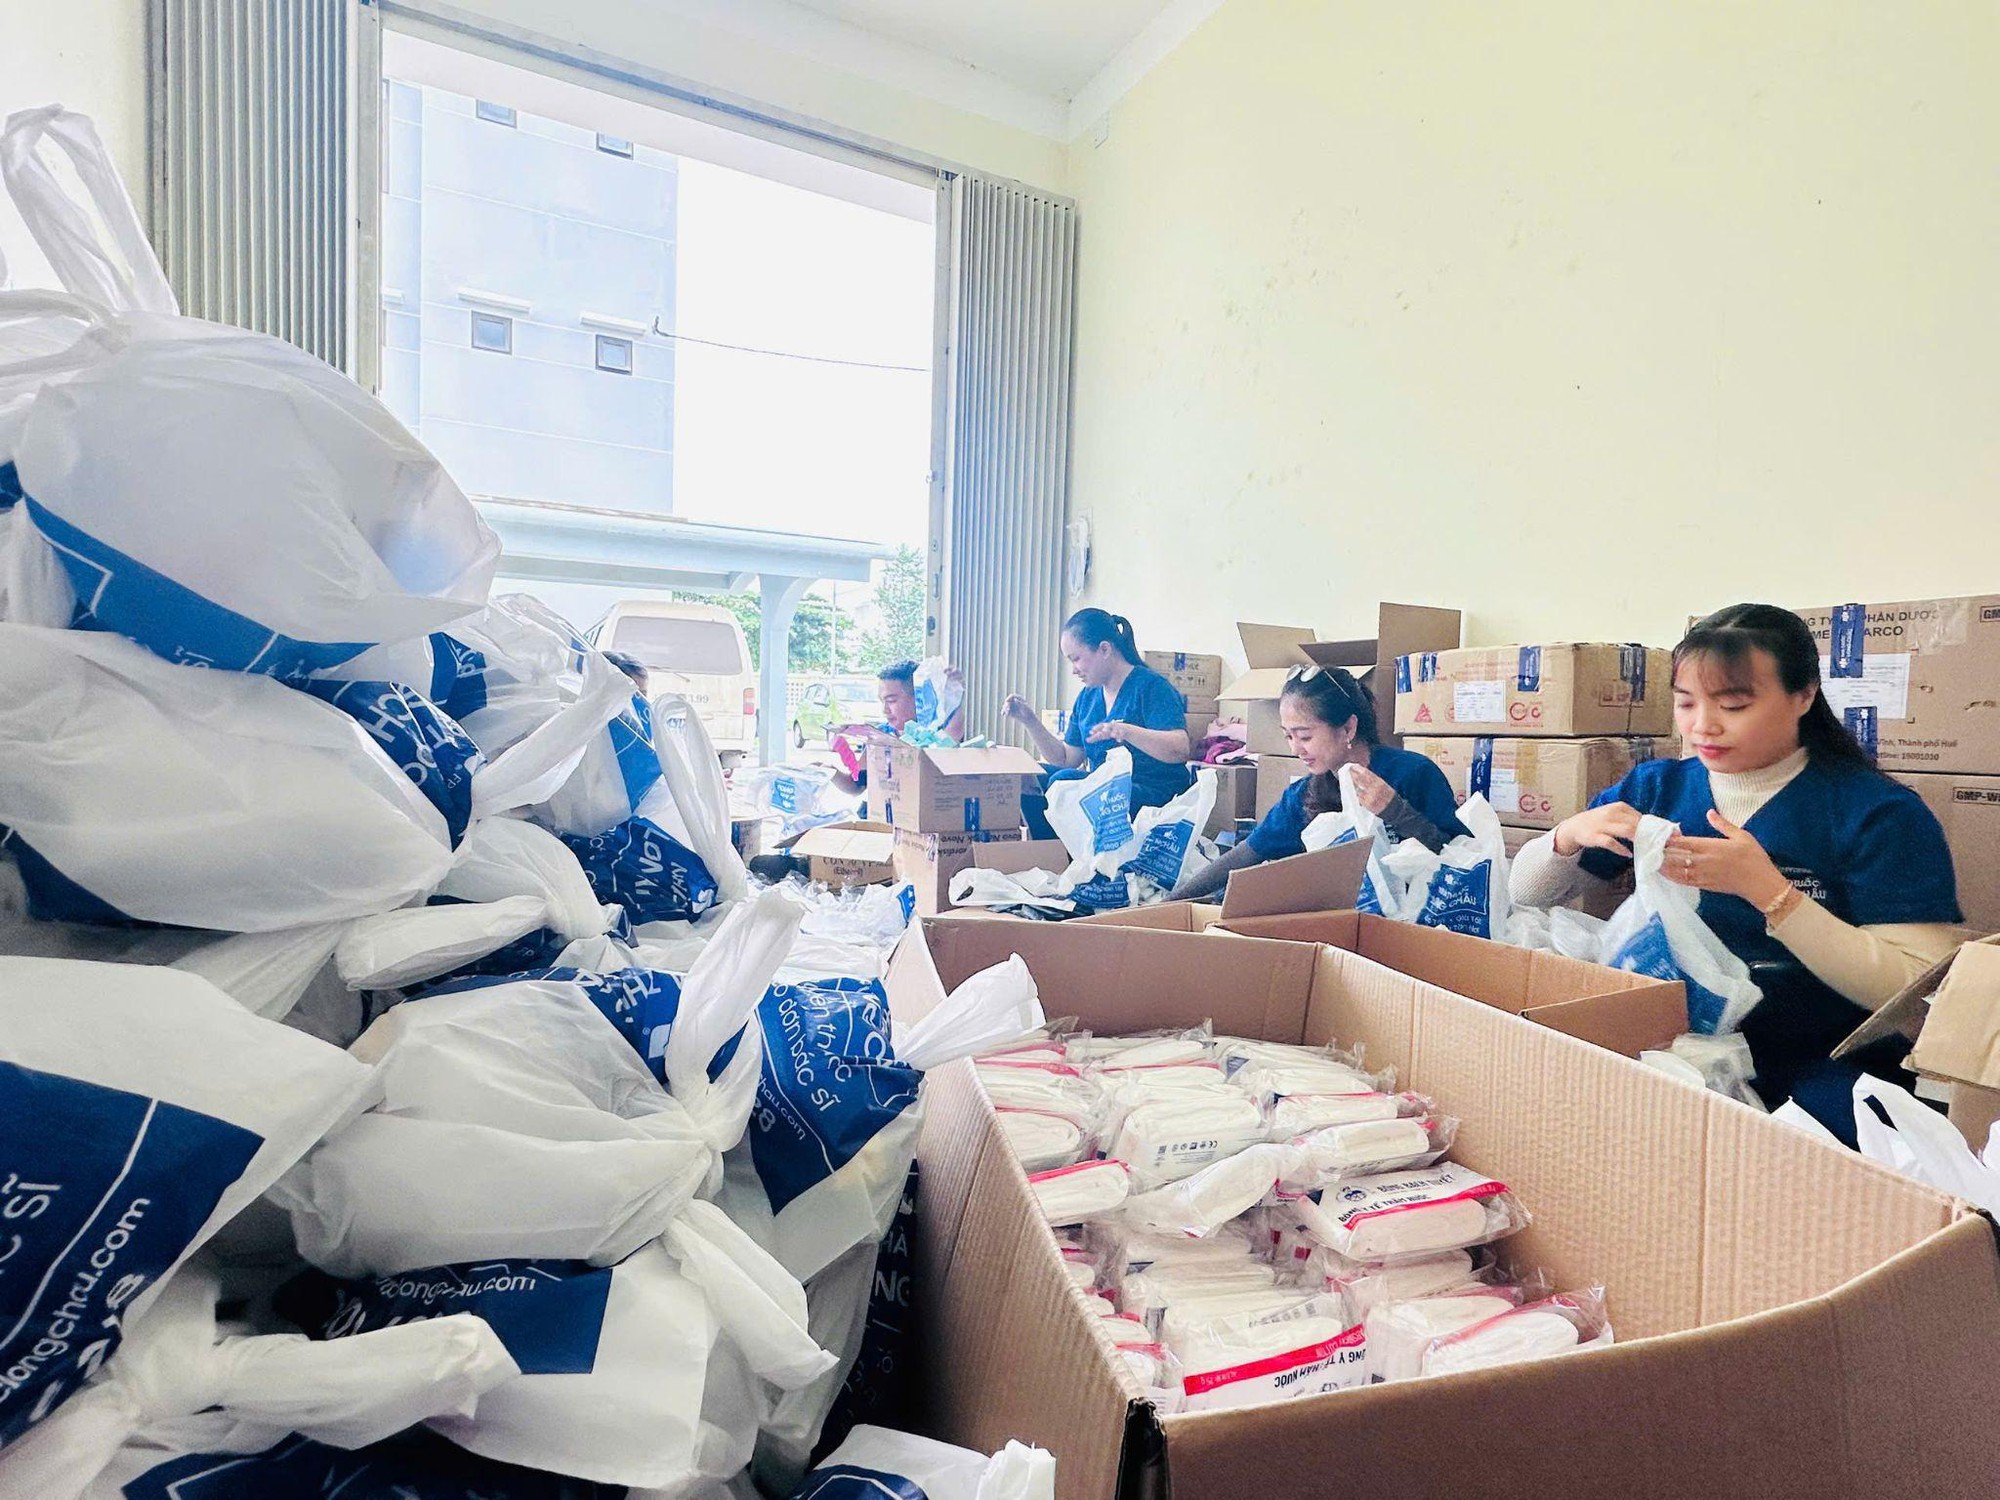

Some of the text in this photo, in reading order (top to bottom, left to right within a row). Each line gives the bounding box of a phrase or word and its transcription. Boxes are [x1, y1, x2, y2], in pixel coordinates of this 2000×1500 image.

[778, 997, 802, 1042] đơn
[790, 1033, 815, 1087] bác
[811, 1087, 842, 1112] sĩ
[757, 1074, 807, 1141] hau.com
[1338, 1352, 1346, 1364] Y
